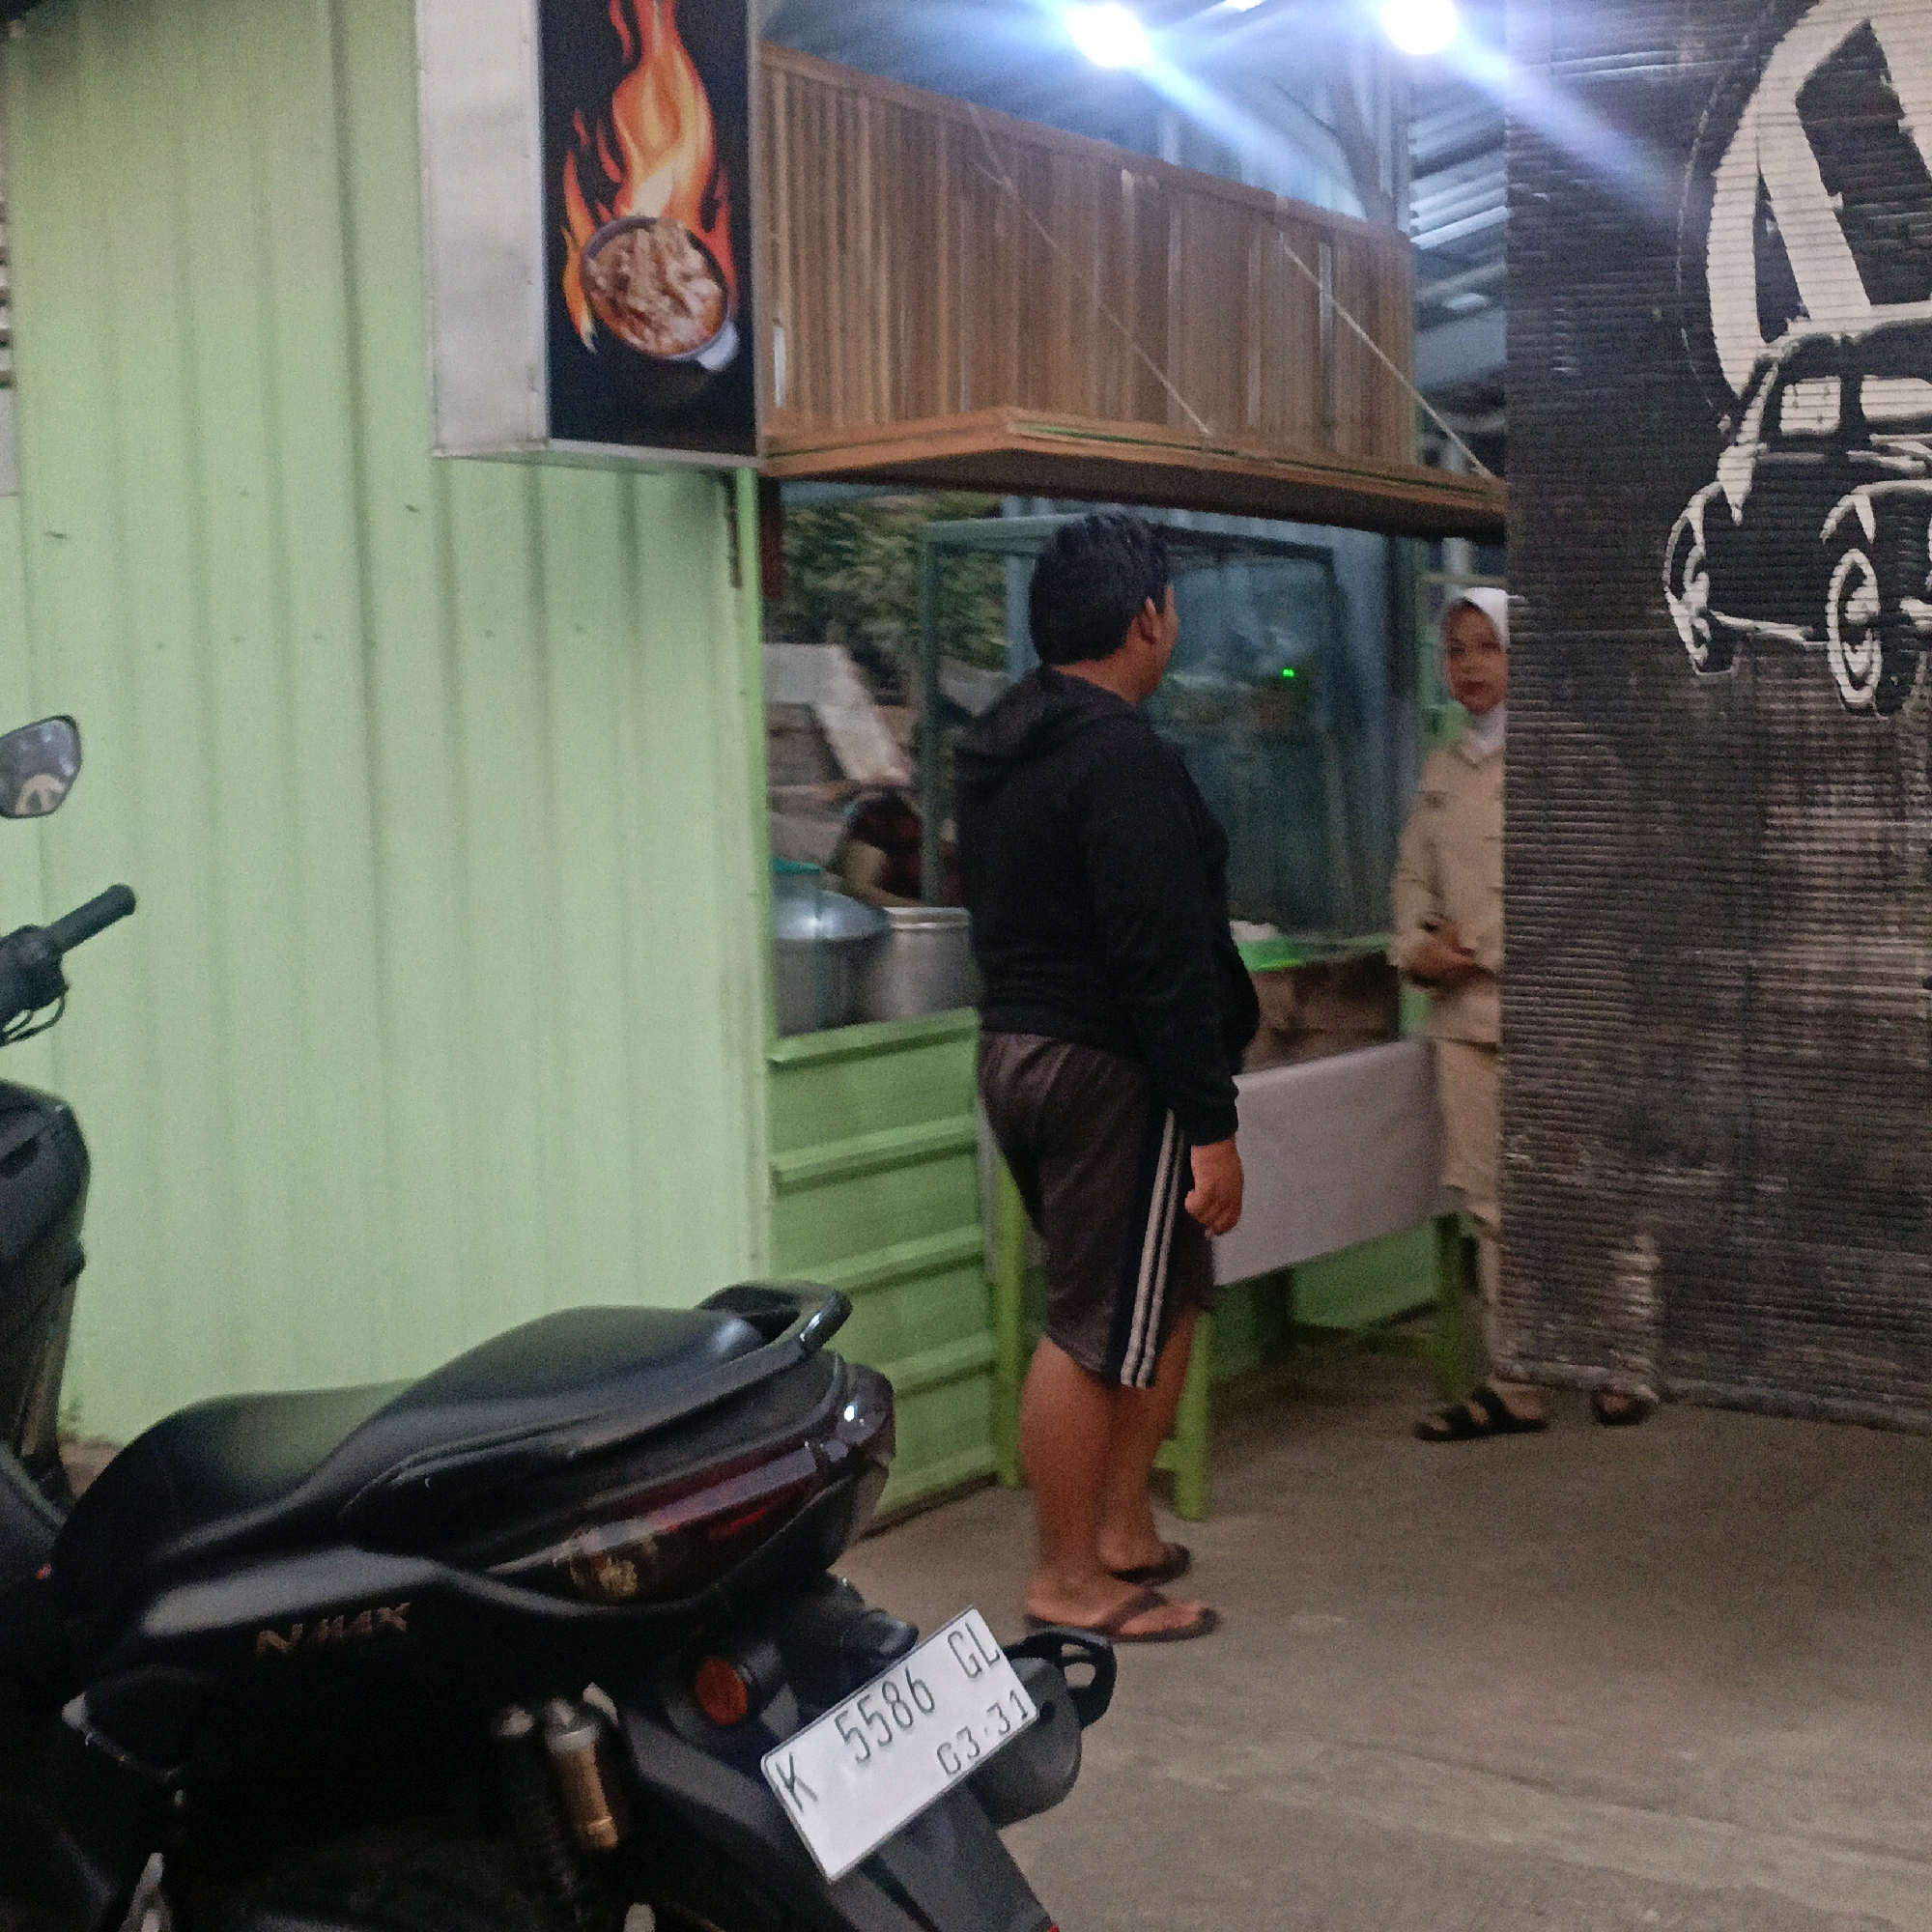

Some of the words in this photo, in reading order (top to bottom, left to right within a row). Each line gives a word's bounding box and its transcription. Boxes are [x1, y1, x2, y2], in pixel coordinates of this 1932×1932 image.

[776, 1751, 818, 1812] K
[834, 1666, 935, 1764] 5586
[947, 1622, 1001, 1679] GL
